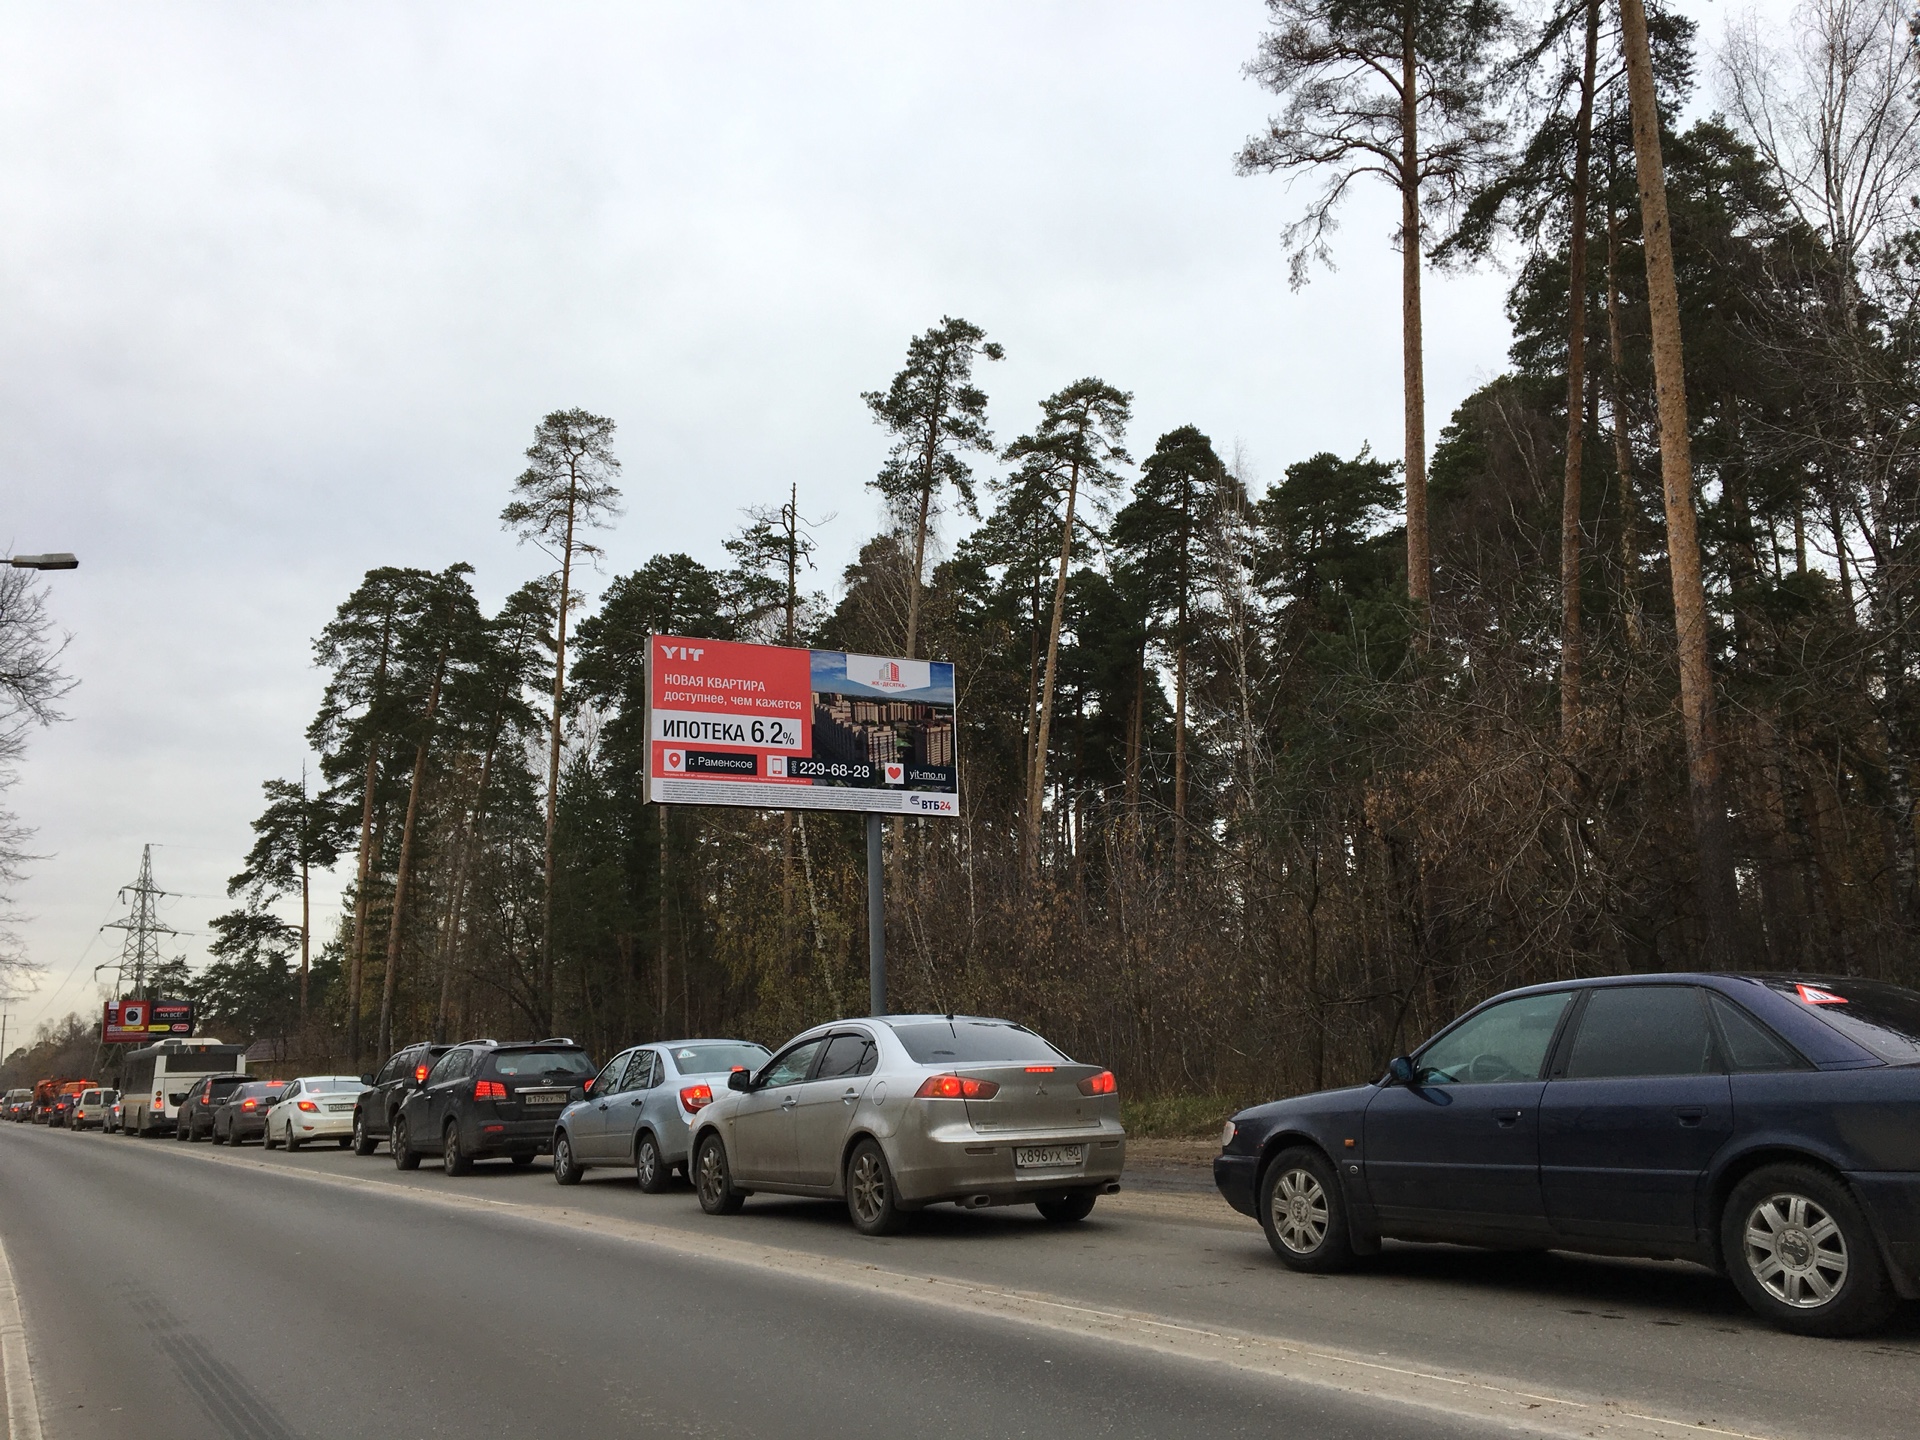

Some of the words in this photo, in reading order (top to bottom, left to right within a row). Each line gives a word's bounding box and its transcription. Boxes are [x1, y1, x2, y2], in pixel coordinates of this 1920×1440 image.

[660, 645, 704, 662] YIT
[664, 673, 703, 687] НОВАЯ
[707, 677, 766, 693] КВАРТИРА
[663, 691, 727, 706] доступнее,
[730, 696, 753, 706] чем
[755, 698, 802, 711] кажется
[663, 719, 746, 742] ИПОТЕКА
[751, 720, 795, 745] 6.2%
[688, 758, 695, 766] г.
[698, 756, 754, 769] Раменское
[799, 761, 870, 778] 229-68-28
[909, 769, 946, 782] yit-mo.ru
[922, 800, 951, 811] ВТБ24
[1019, 1149, 1062, 1164] Х896УХ
[1064, 1146, 1079, 1157] 150
